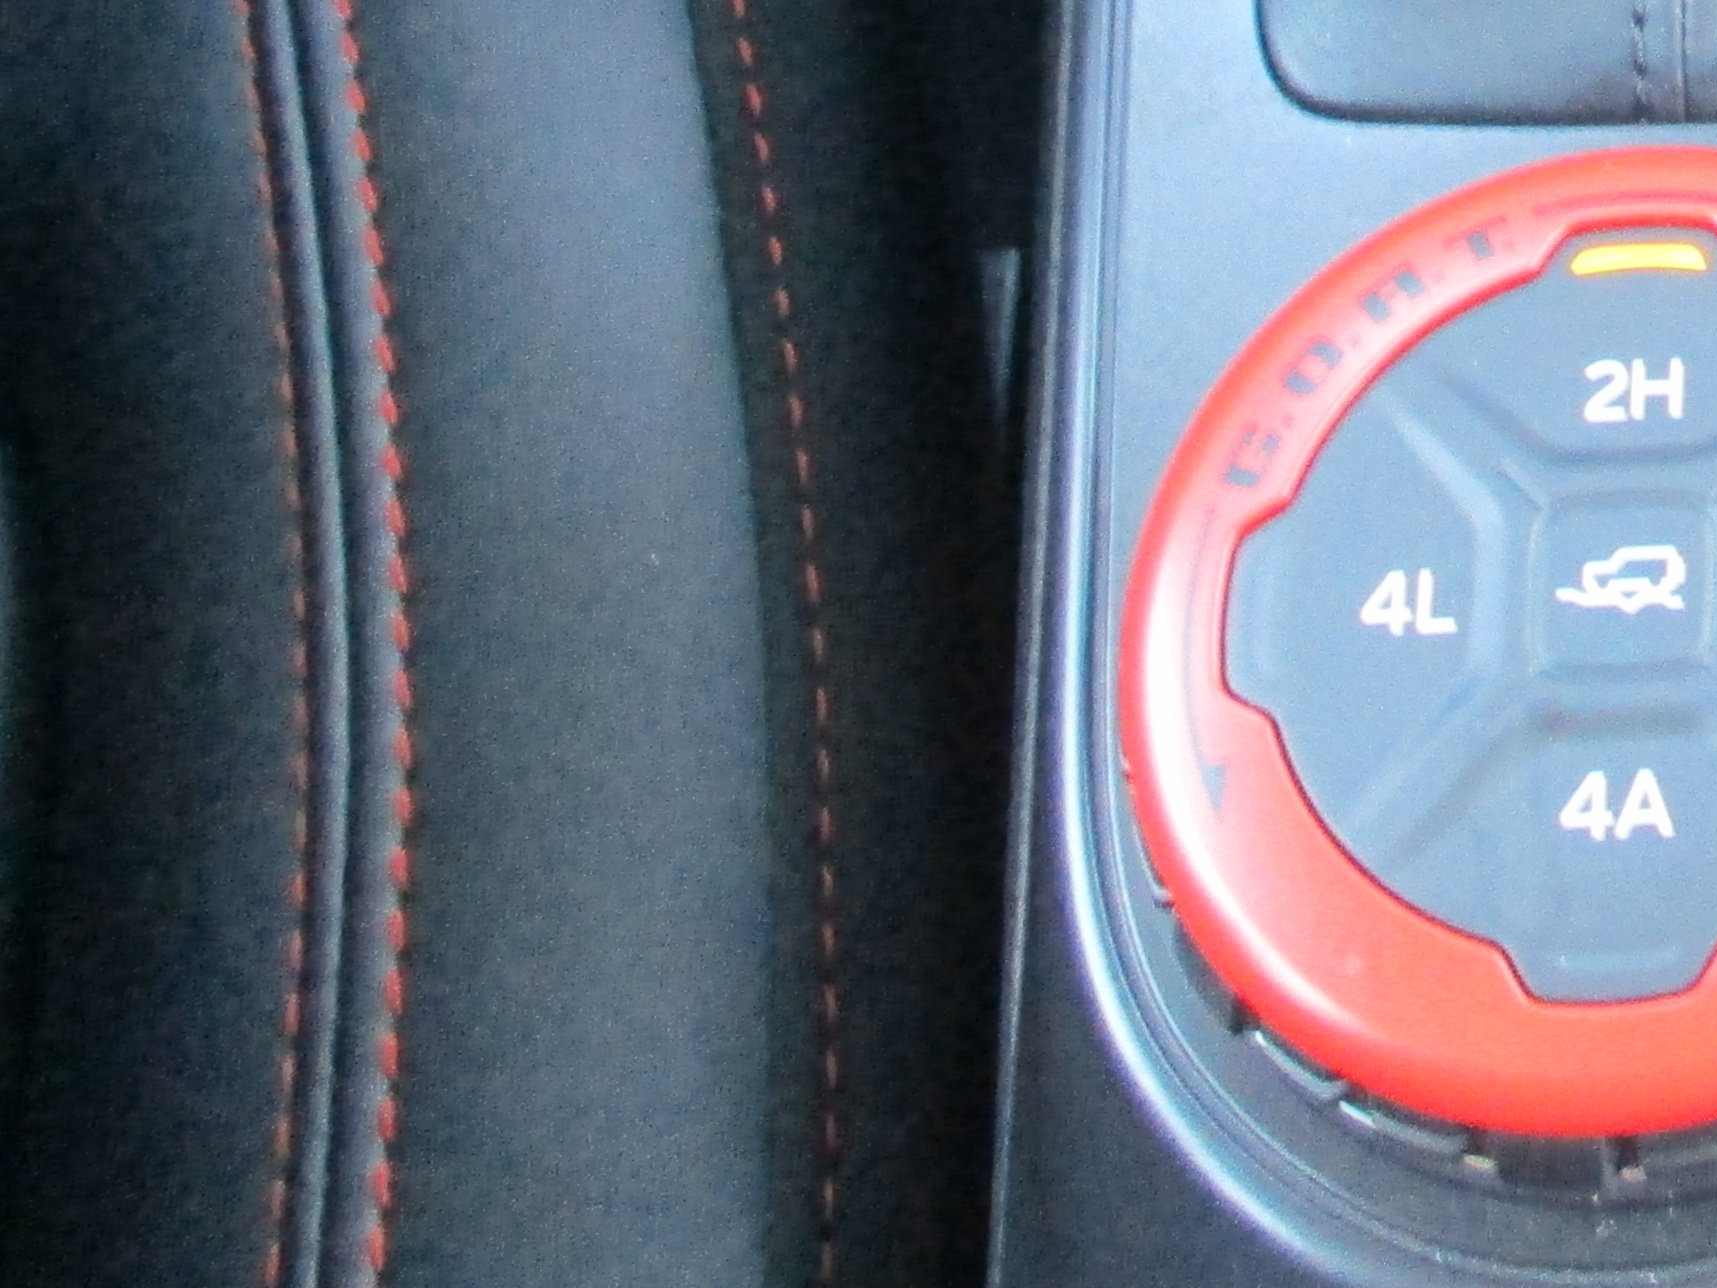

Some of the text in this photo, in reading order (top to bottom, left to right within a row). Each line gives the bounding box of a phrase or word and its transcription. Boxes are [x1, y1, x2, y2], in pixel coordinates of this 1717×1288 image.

[1582, 357, 1686, 423] 2H
[1359, 569, 1457, 636] 4L
[1558, 768, 1675, 841] 4A
